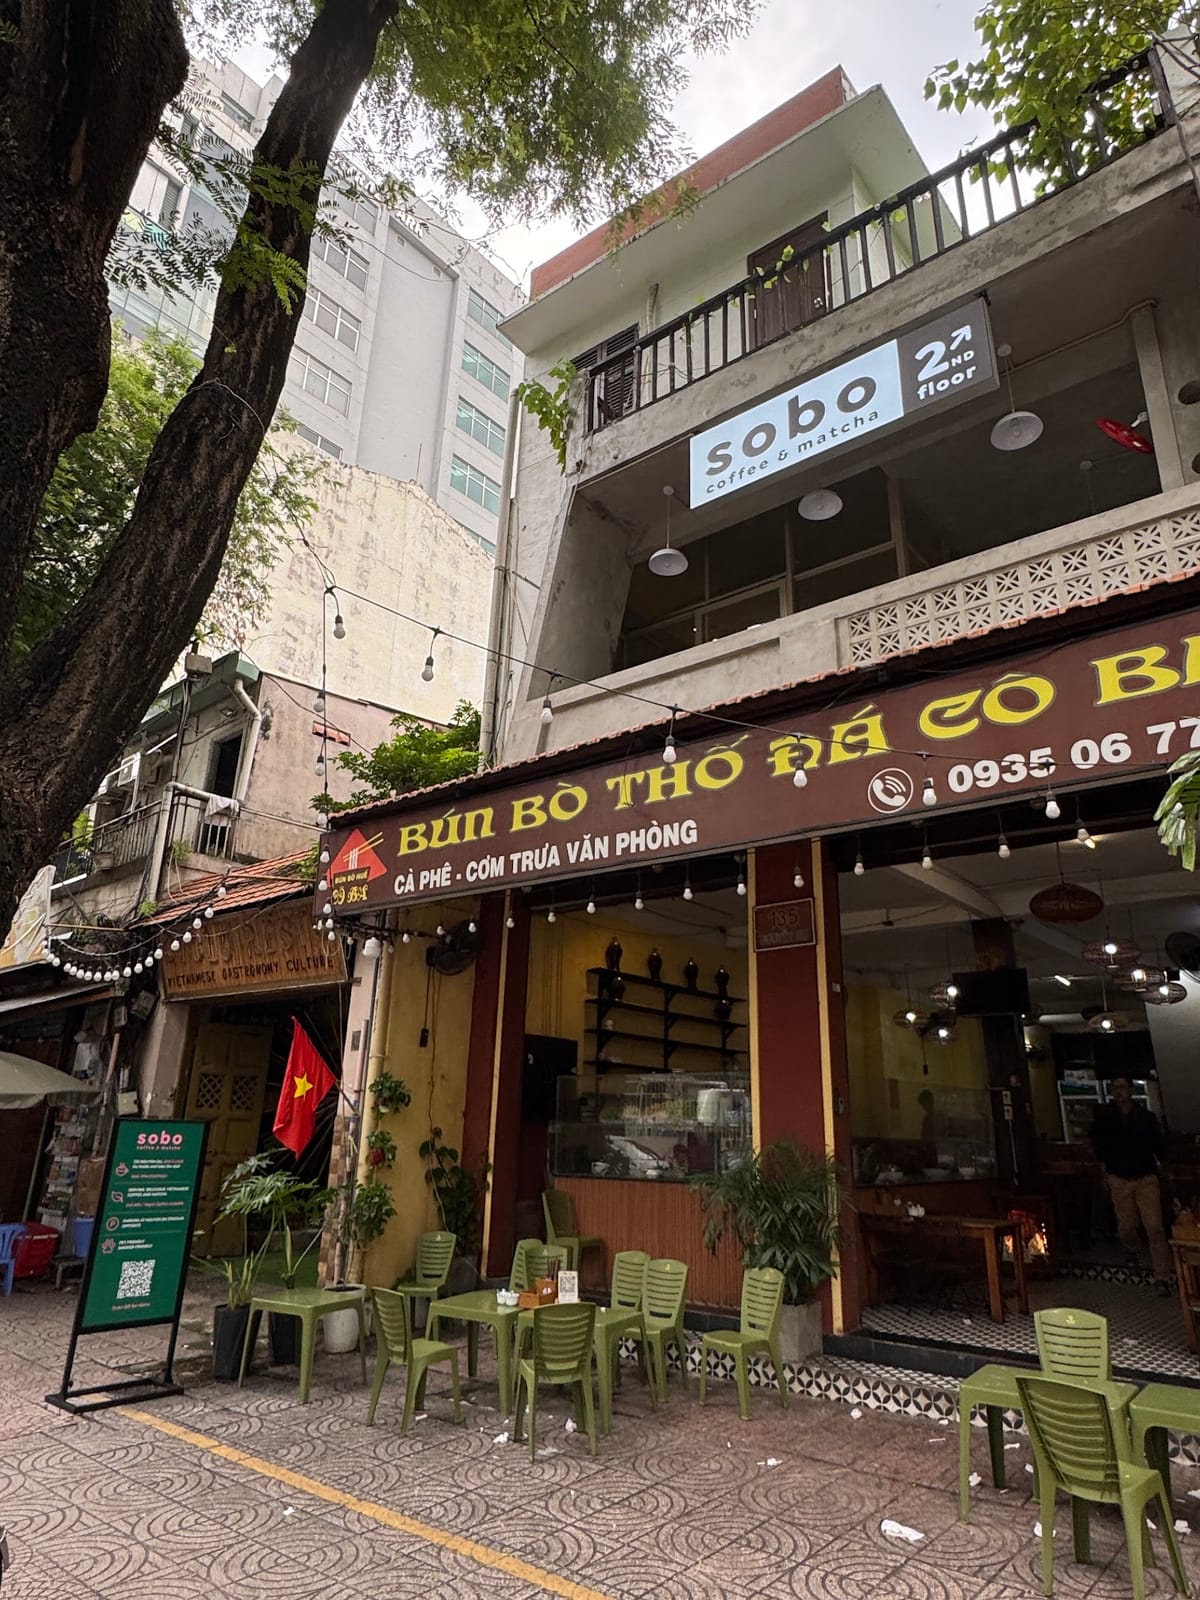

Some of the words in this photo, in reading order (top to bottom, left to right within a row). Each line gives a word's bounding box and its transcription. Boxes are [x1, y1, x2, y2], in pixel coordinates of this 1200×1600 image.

[917, 364, 976, 400] floor
[706, 376, 877, 476] sobo
[706, 459, 769, 494] coffee
[777, 449, 789, 462] &
[798, 410, 879, 454] matcha
[509, 781, 588, 833] BÒ
[919, 672, 1056, 739] CÔ
[1088, 632, 1200, 706] B
[947, 746, 1057, 793] 0935
[1070, 732, 1132, 770] 06
[394, 868, 415, 895] CÀ
[419, 861, 452, 890] PHÊ
[465, 854, 505, 882] CƠM
[509, 842, 561, 874] TRƯA
[566, 833, 609, 864] VĂN
[615, 819, 698, 856] PHÒNG
[137, 1130, 183, 1145] sobo
